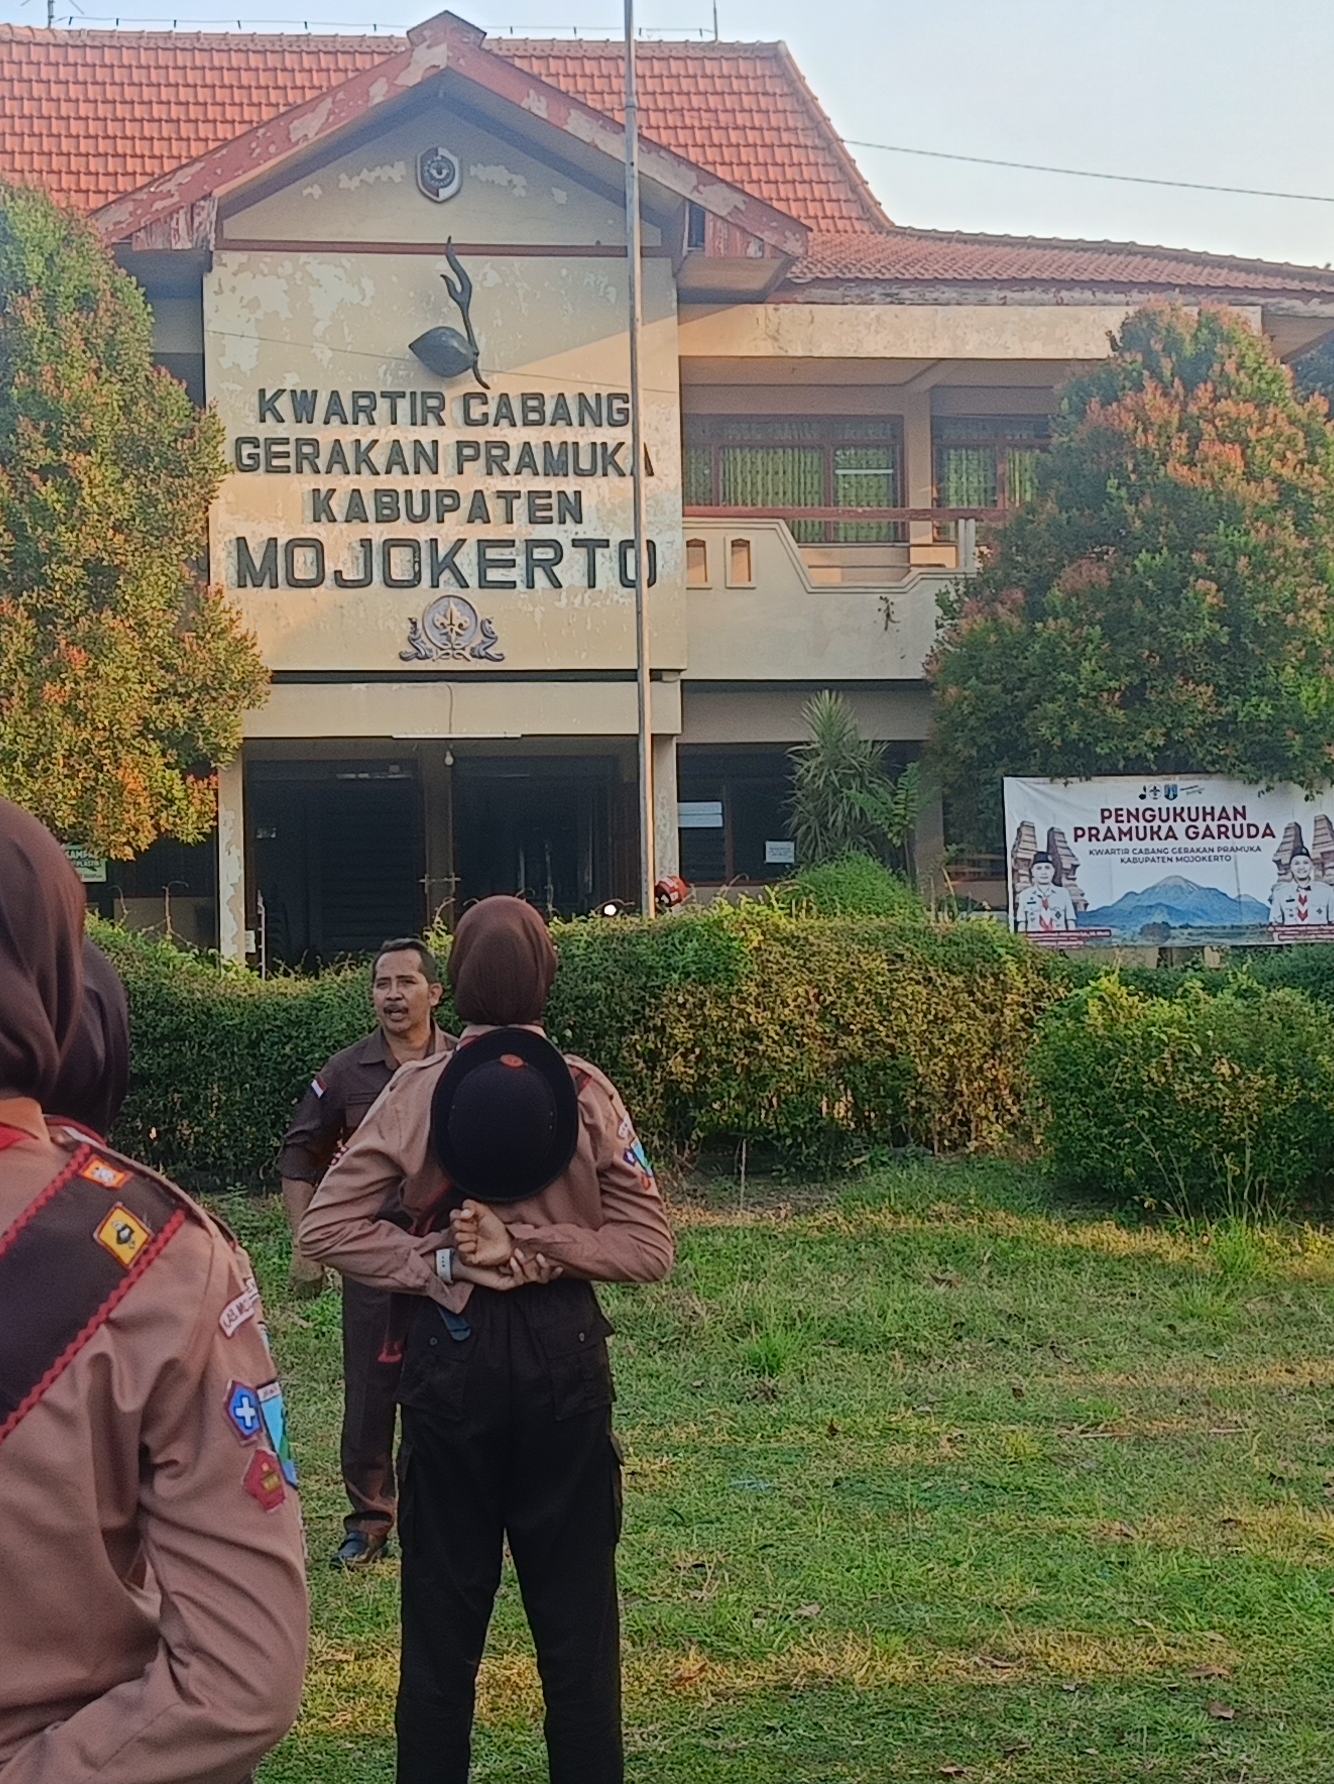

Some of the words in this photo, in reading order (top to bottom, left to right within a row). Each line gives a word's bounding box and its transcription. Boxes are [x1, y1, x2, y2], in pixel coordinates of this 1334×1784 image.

[258, 388, 446, 426] KWARTIR
[462, 391, 630, 428] CABANG
[234, 436, 439, 475] GERAKAN
[456, 440, 655, 477] PRAMUKA
[312, 488, 583, 524] KABUPATEN
[236, 536, 657, 589] MOJOKERTO
[1100, 805, 1247, 824] PENGUKUHAN
[1073, 825, 1179, 843] PRAMUKA
[1185, 822, 1276, 841] GARUDA
[1089, 848, 1130, 856] KWARTIR
[1132, 847, 1169, 855] CABANG
[1171, 846, 1215, 854] GERAKAN
[1217, 845, 1262, 853] PRAMUKA
[1120, 856, 1173, 864] KABUPATEN
[1175, 854, 1232, 863] MOJOKERTO
